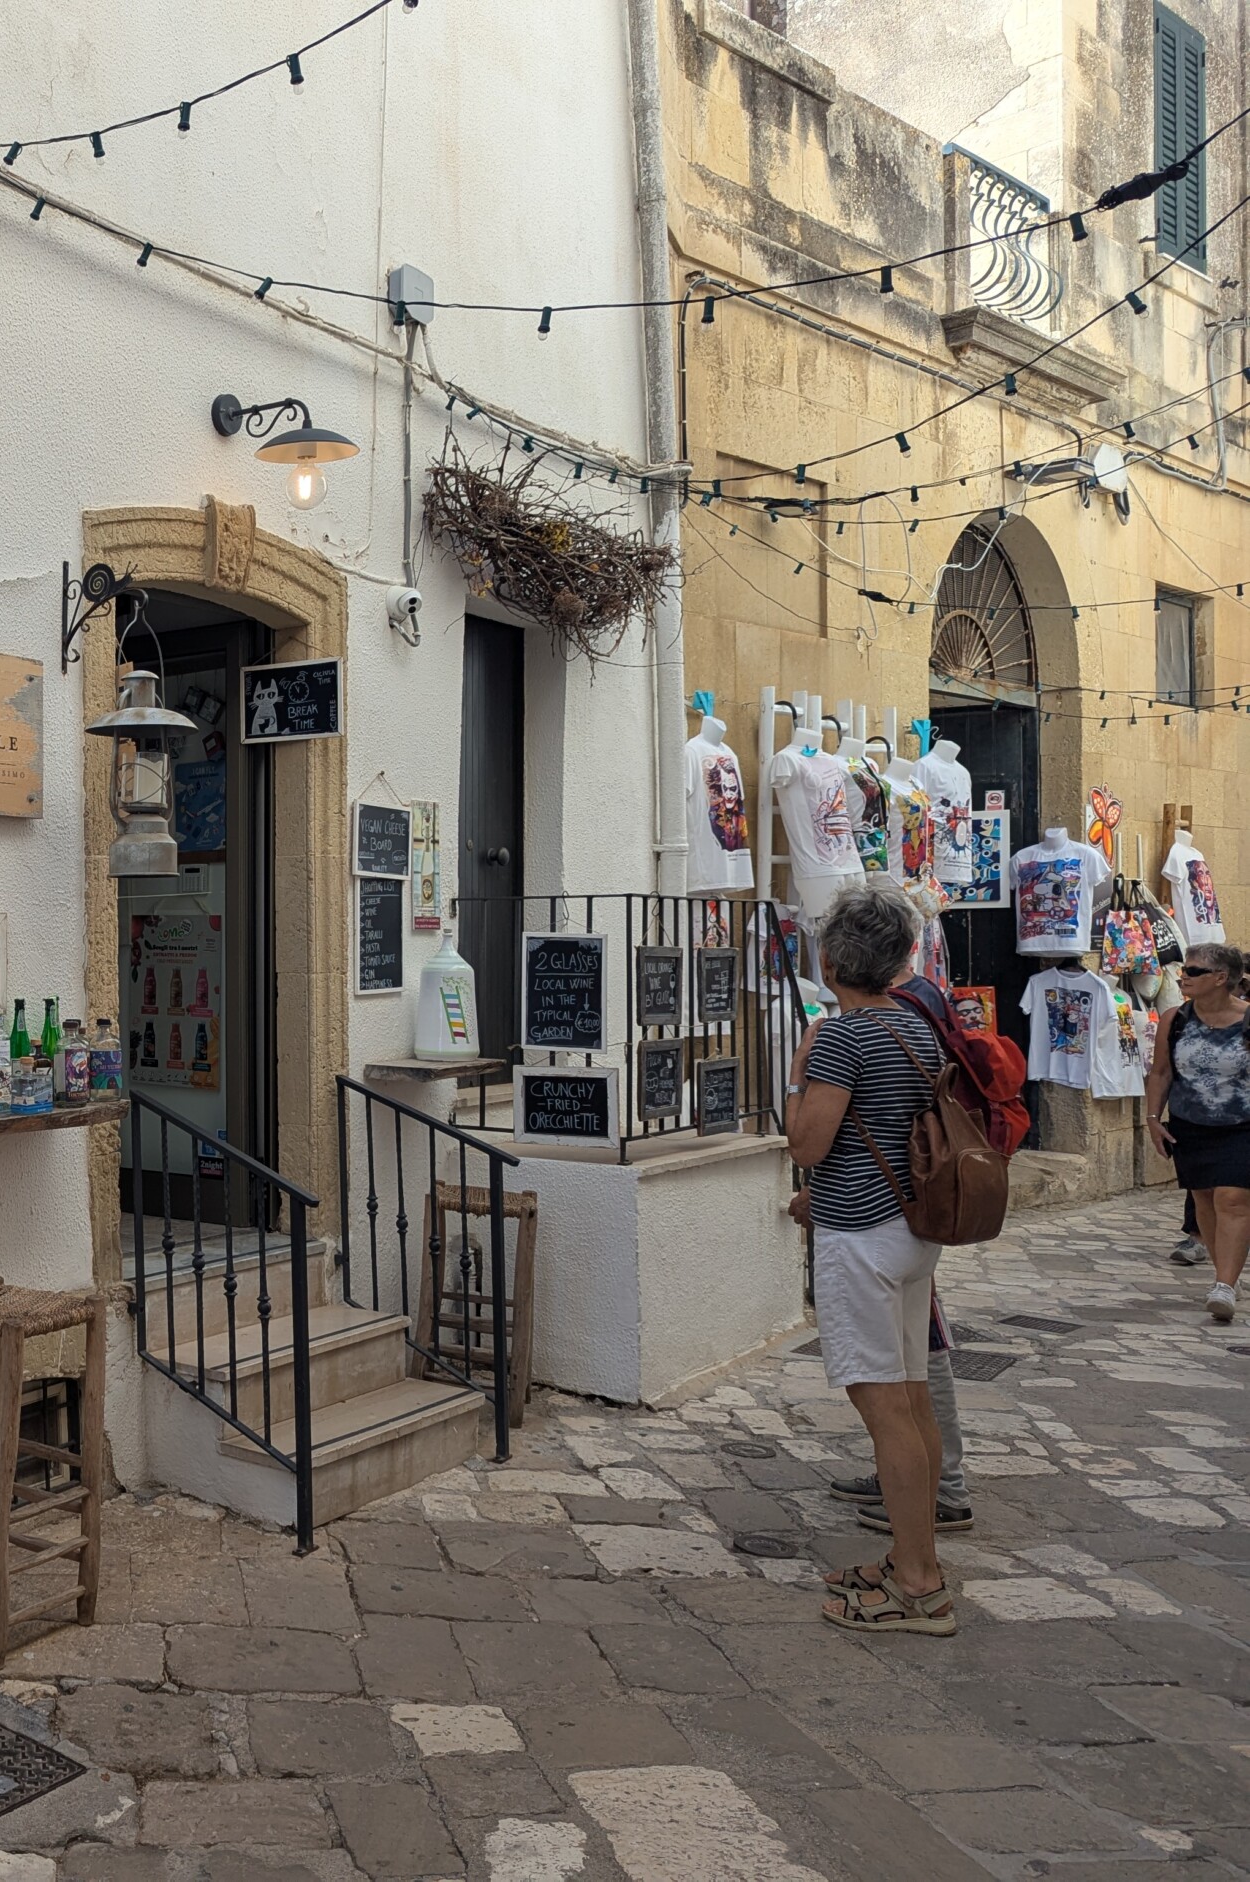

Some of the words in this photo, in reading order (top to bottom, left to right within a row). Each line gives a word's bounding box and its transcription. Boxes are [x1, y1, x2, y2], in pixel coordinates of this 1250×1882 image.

[287, 703, 319, 719] BREAK
[292, 718, 315, 731] TIME
[360, 818, 383, 834] VEGAN
[384, 820, 406, 837] CHEESE
[370, 836, 392, 851] BOARD
[384, 880, 396, 892] LIST
[365, 906, 378, 917] WINE
[363, 930, 383, 941] TARALLI
[365, 942, 381, 953] PASTA
[535, 951, 548, 972] 2
[549, 952, 599, 973] GLASSES
[365, 969, 375, 980] GIN
[365, 979, 393, 989] HAPPINESS
[533, 977, 567, 991] LOCAL
[569, 977, 594, 990] WINE
[541, 993, 554, 1006] IN
[556, 993, 577, 1006] THE
[533, 1008, 574, 1023] TYPICAL
[530, 1026, 574, 1041] GARDEN
[530, 1081, 595, 1098] CRUNCHY
[528, 1111, 601, 1131] ORECCHIETTE
[200, 1160, 223, 1170] 2night
